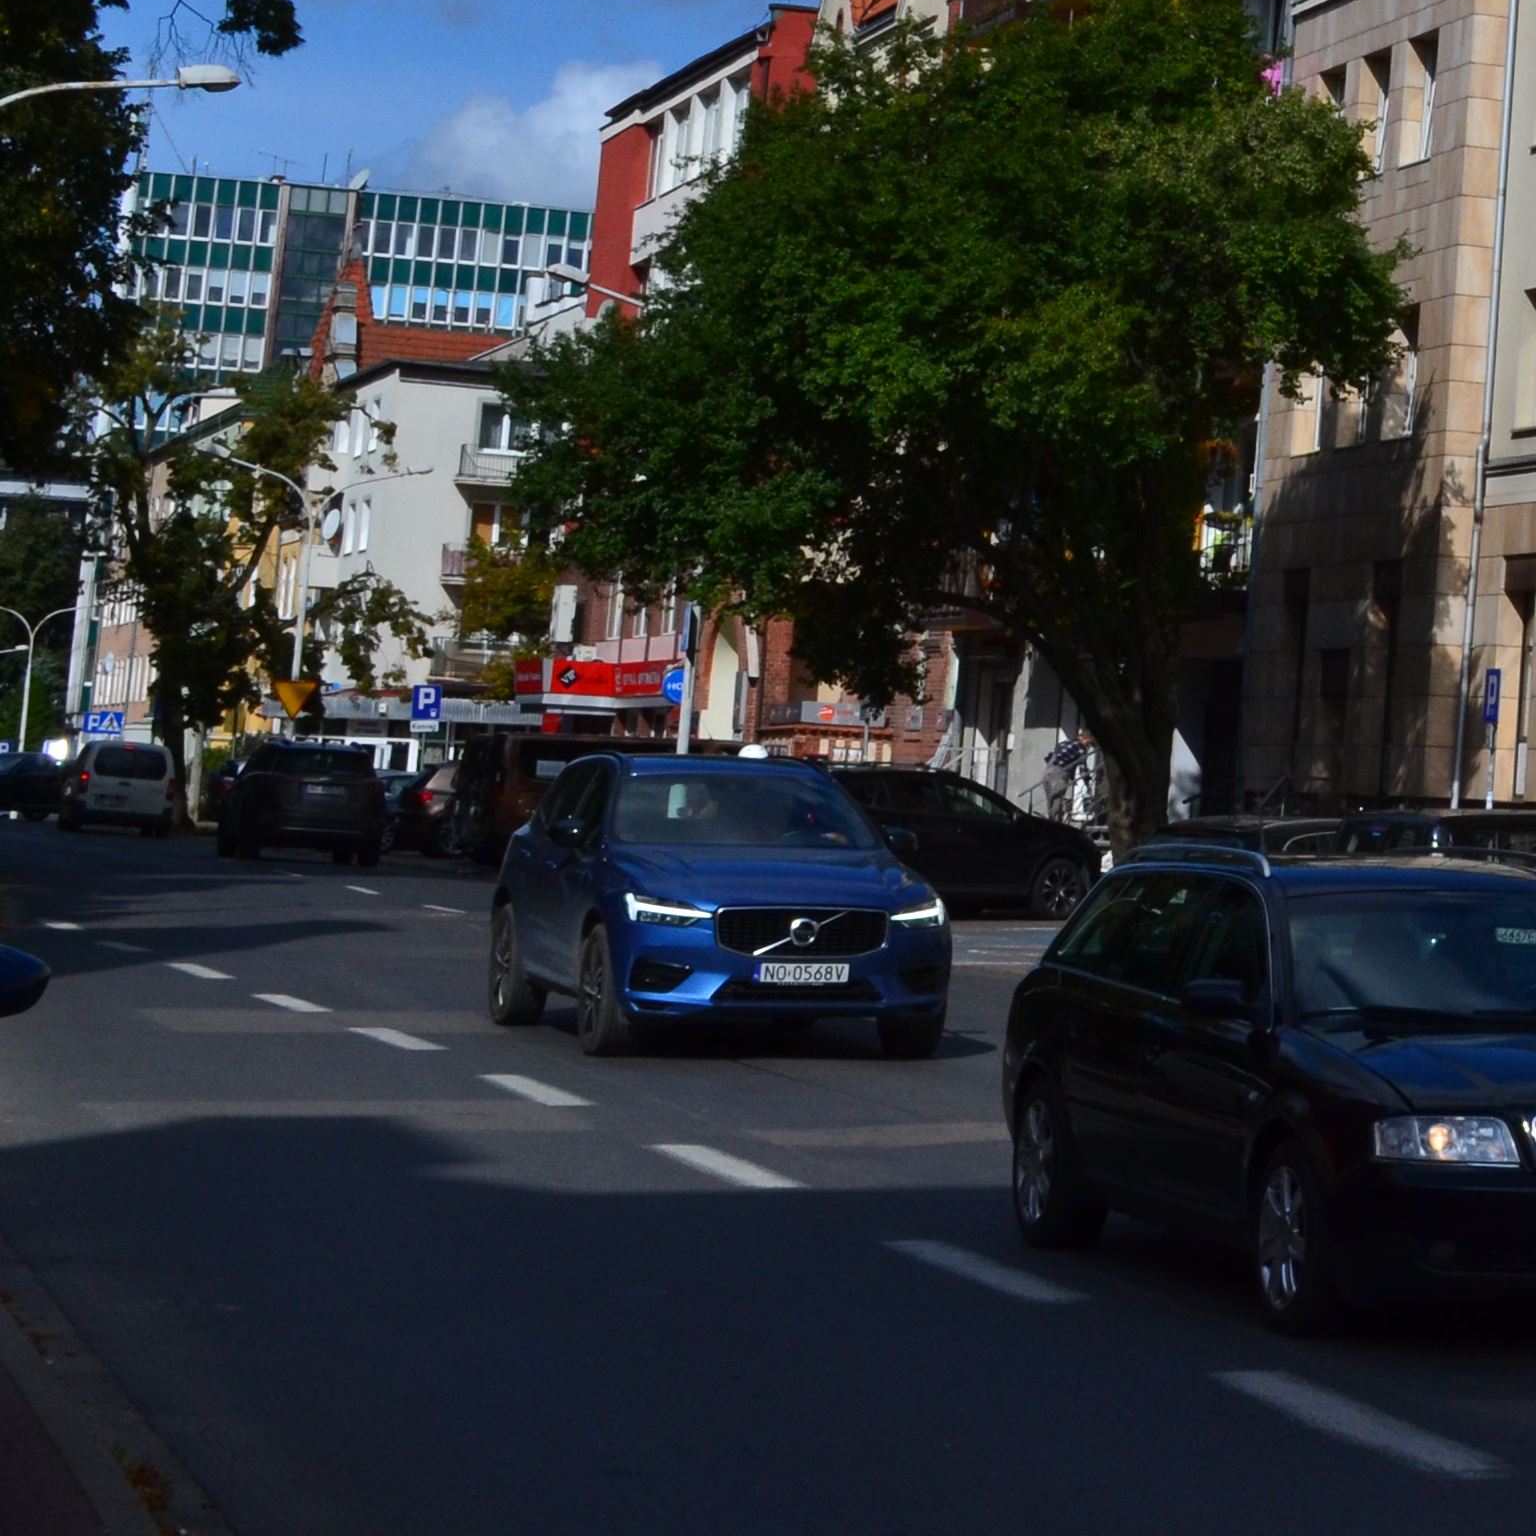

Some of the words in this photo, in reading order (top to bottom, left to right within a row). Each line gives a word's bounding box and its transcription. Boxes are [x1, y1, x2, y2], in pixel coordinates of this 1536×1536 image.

[418, 687, 436, 710] P
[88, 715, 101, 731] P
[764, 965, 787, 981] NO
[793, 965, 845, 981] 0568V
